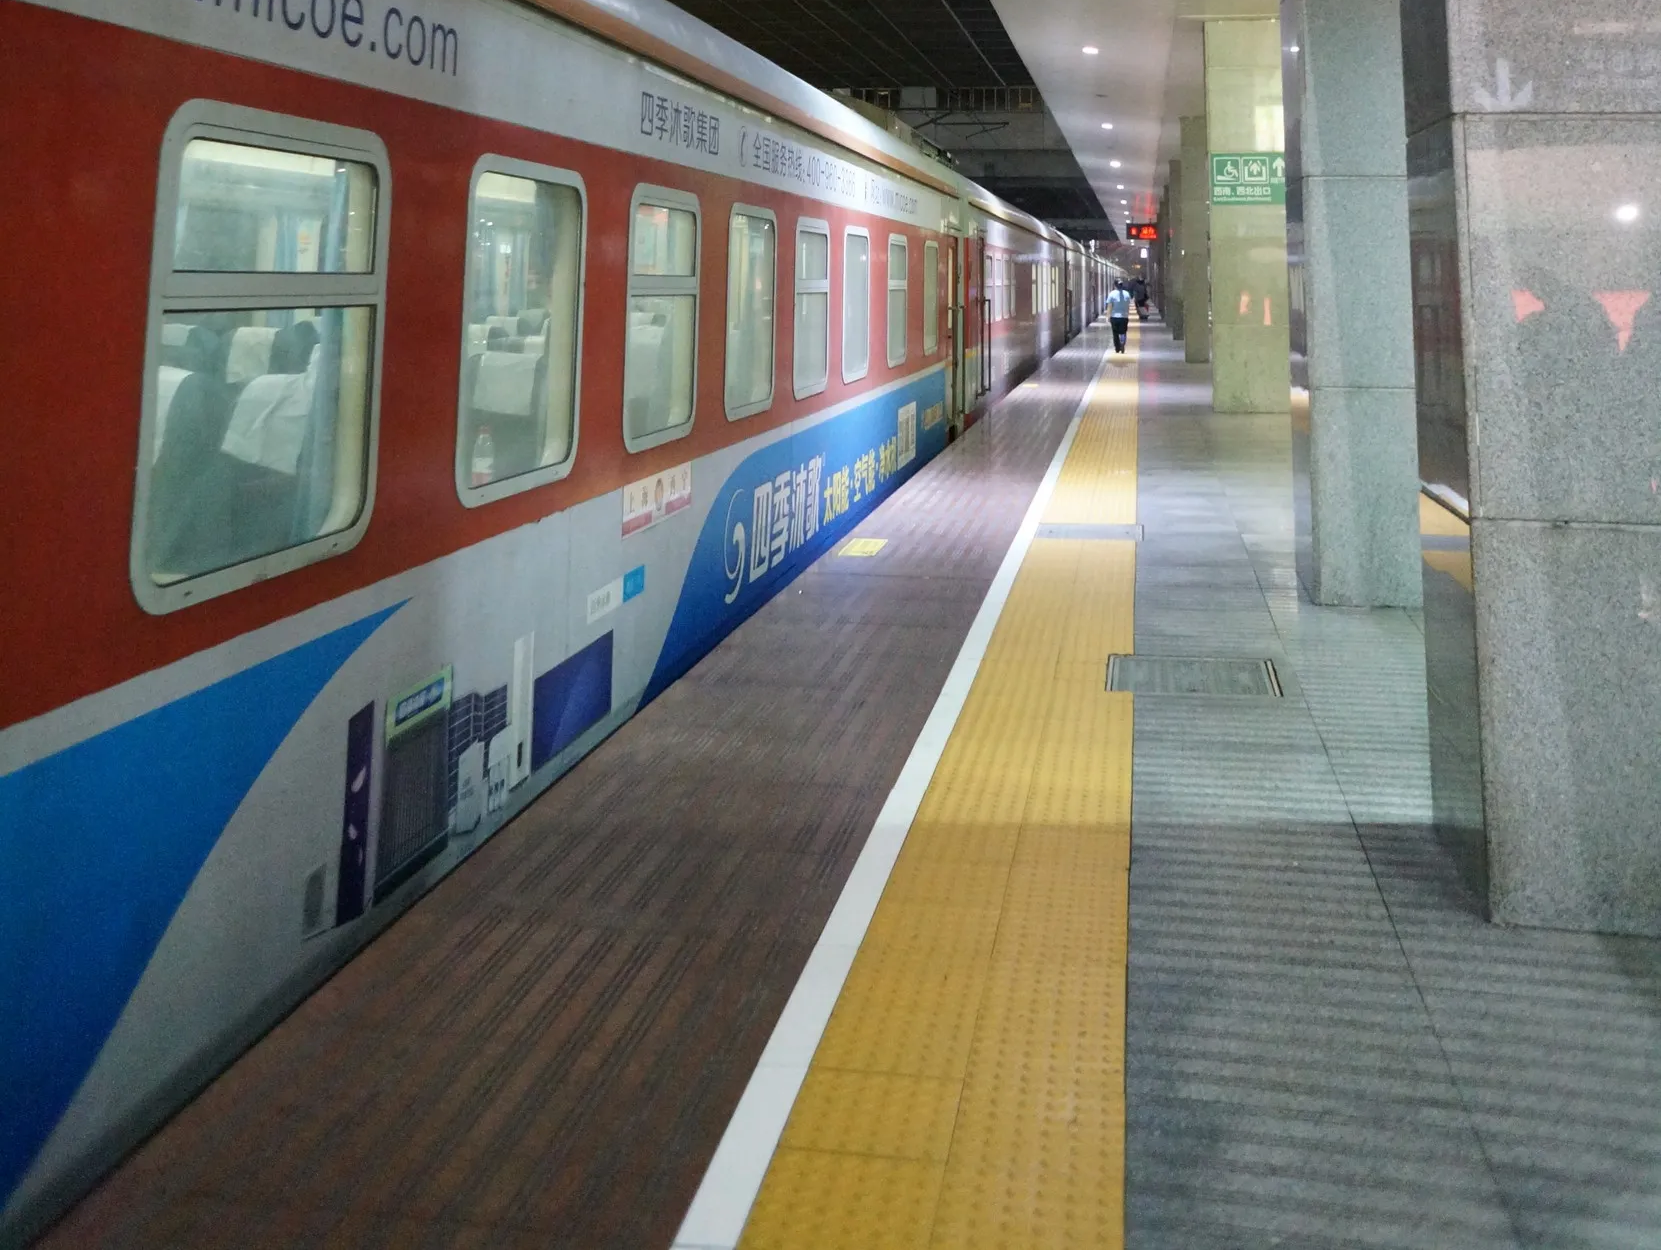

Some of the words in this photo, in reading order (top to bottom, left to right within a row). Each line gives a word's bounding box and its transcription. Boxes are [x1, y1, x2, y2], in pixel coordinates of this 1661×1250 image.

[640, 91, 720, 156] 四季沐歌集团
[749, 455, 823, 583] 四季沐歌
